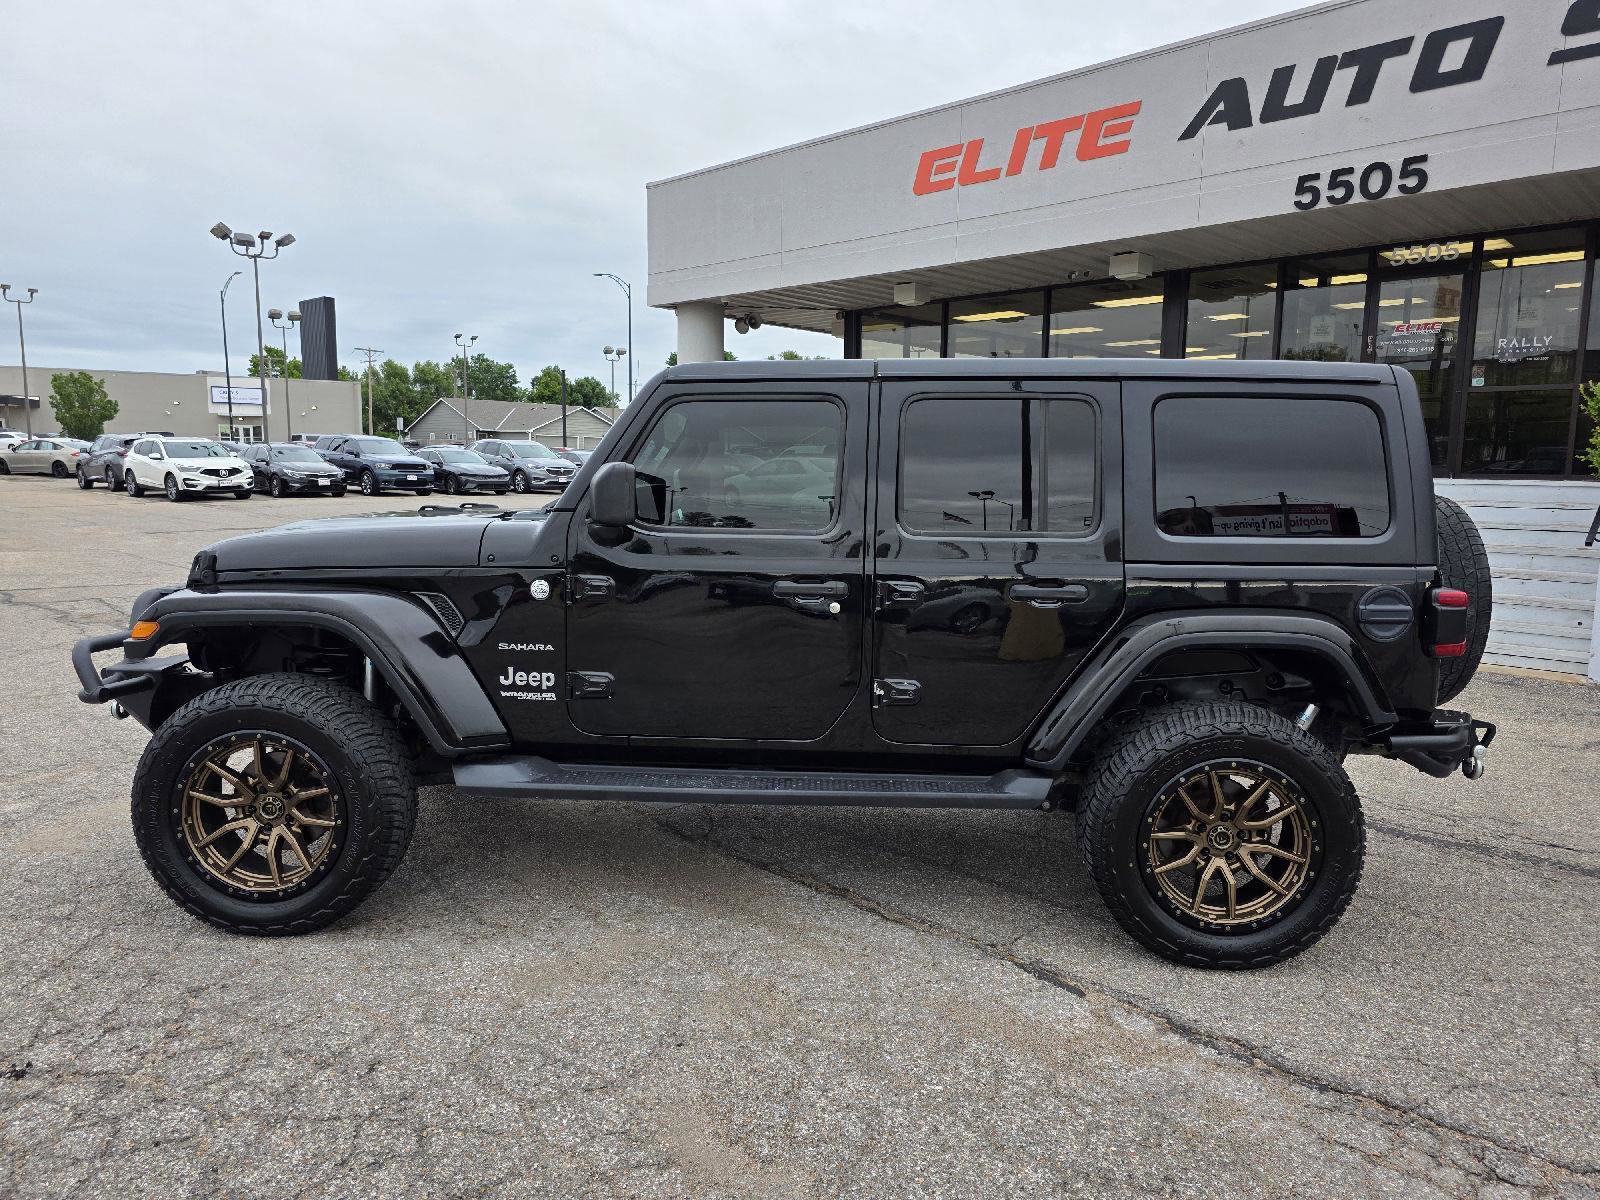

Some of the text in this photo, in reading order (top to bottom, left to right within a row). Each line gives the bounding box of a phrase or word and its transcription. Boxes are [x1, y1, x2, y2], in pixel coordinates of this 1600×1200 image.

[913, 100, 1142, 196] ELITE
[1177, 15, 1505, 141] AUTO
[1293, 153, 1429, 211] 5505
[1389, 240, 1460, 266] 5505
[1393, 322, 1443, 333] ELITE
[1498, 335, 1553, 349] RALLY
[498, 642, 555, 651] SAHARA
[499, 666, 556, 690] Jeep
[499, 690, 557, 698] WRANGLER
